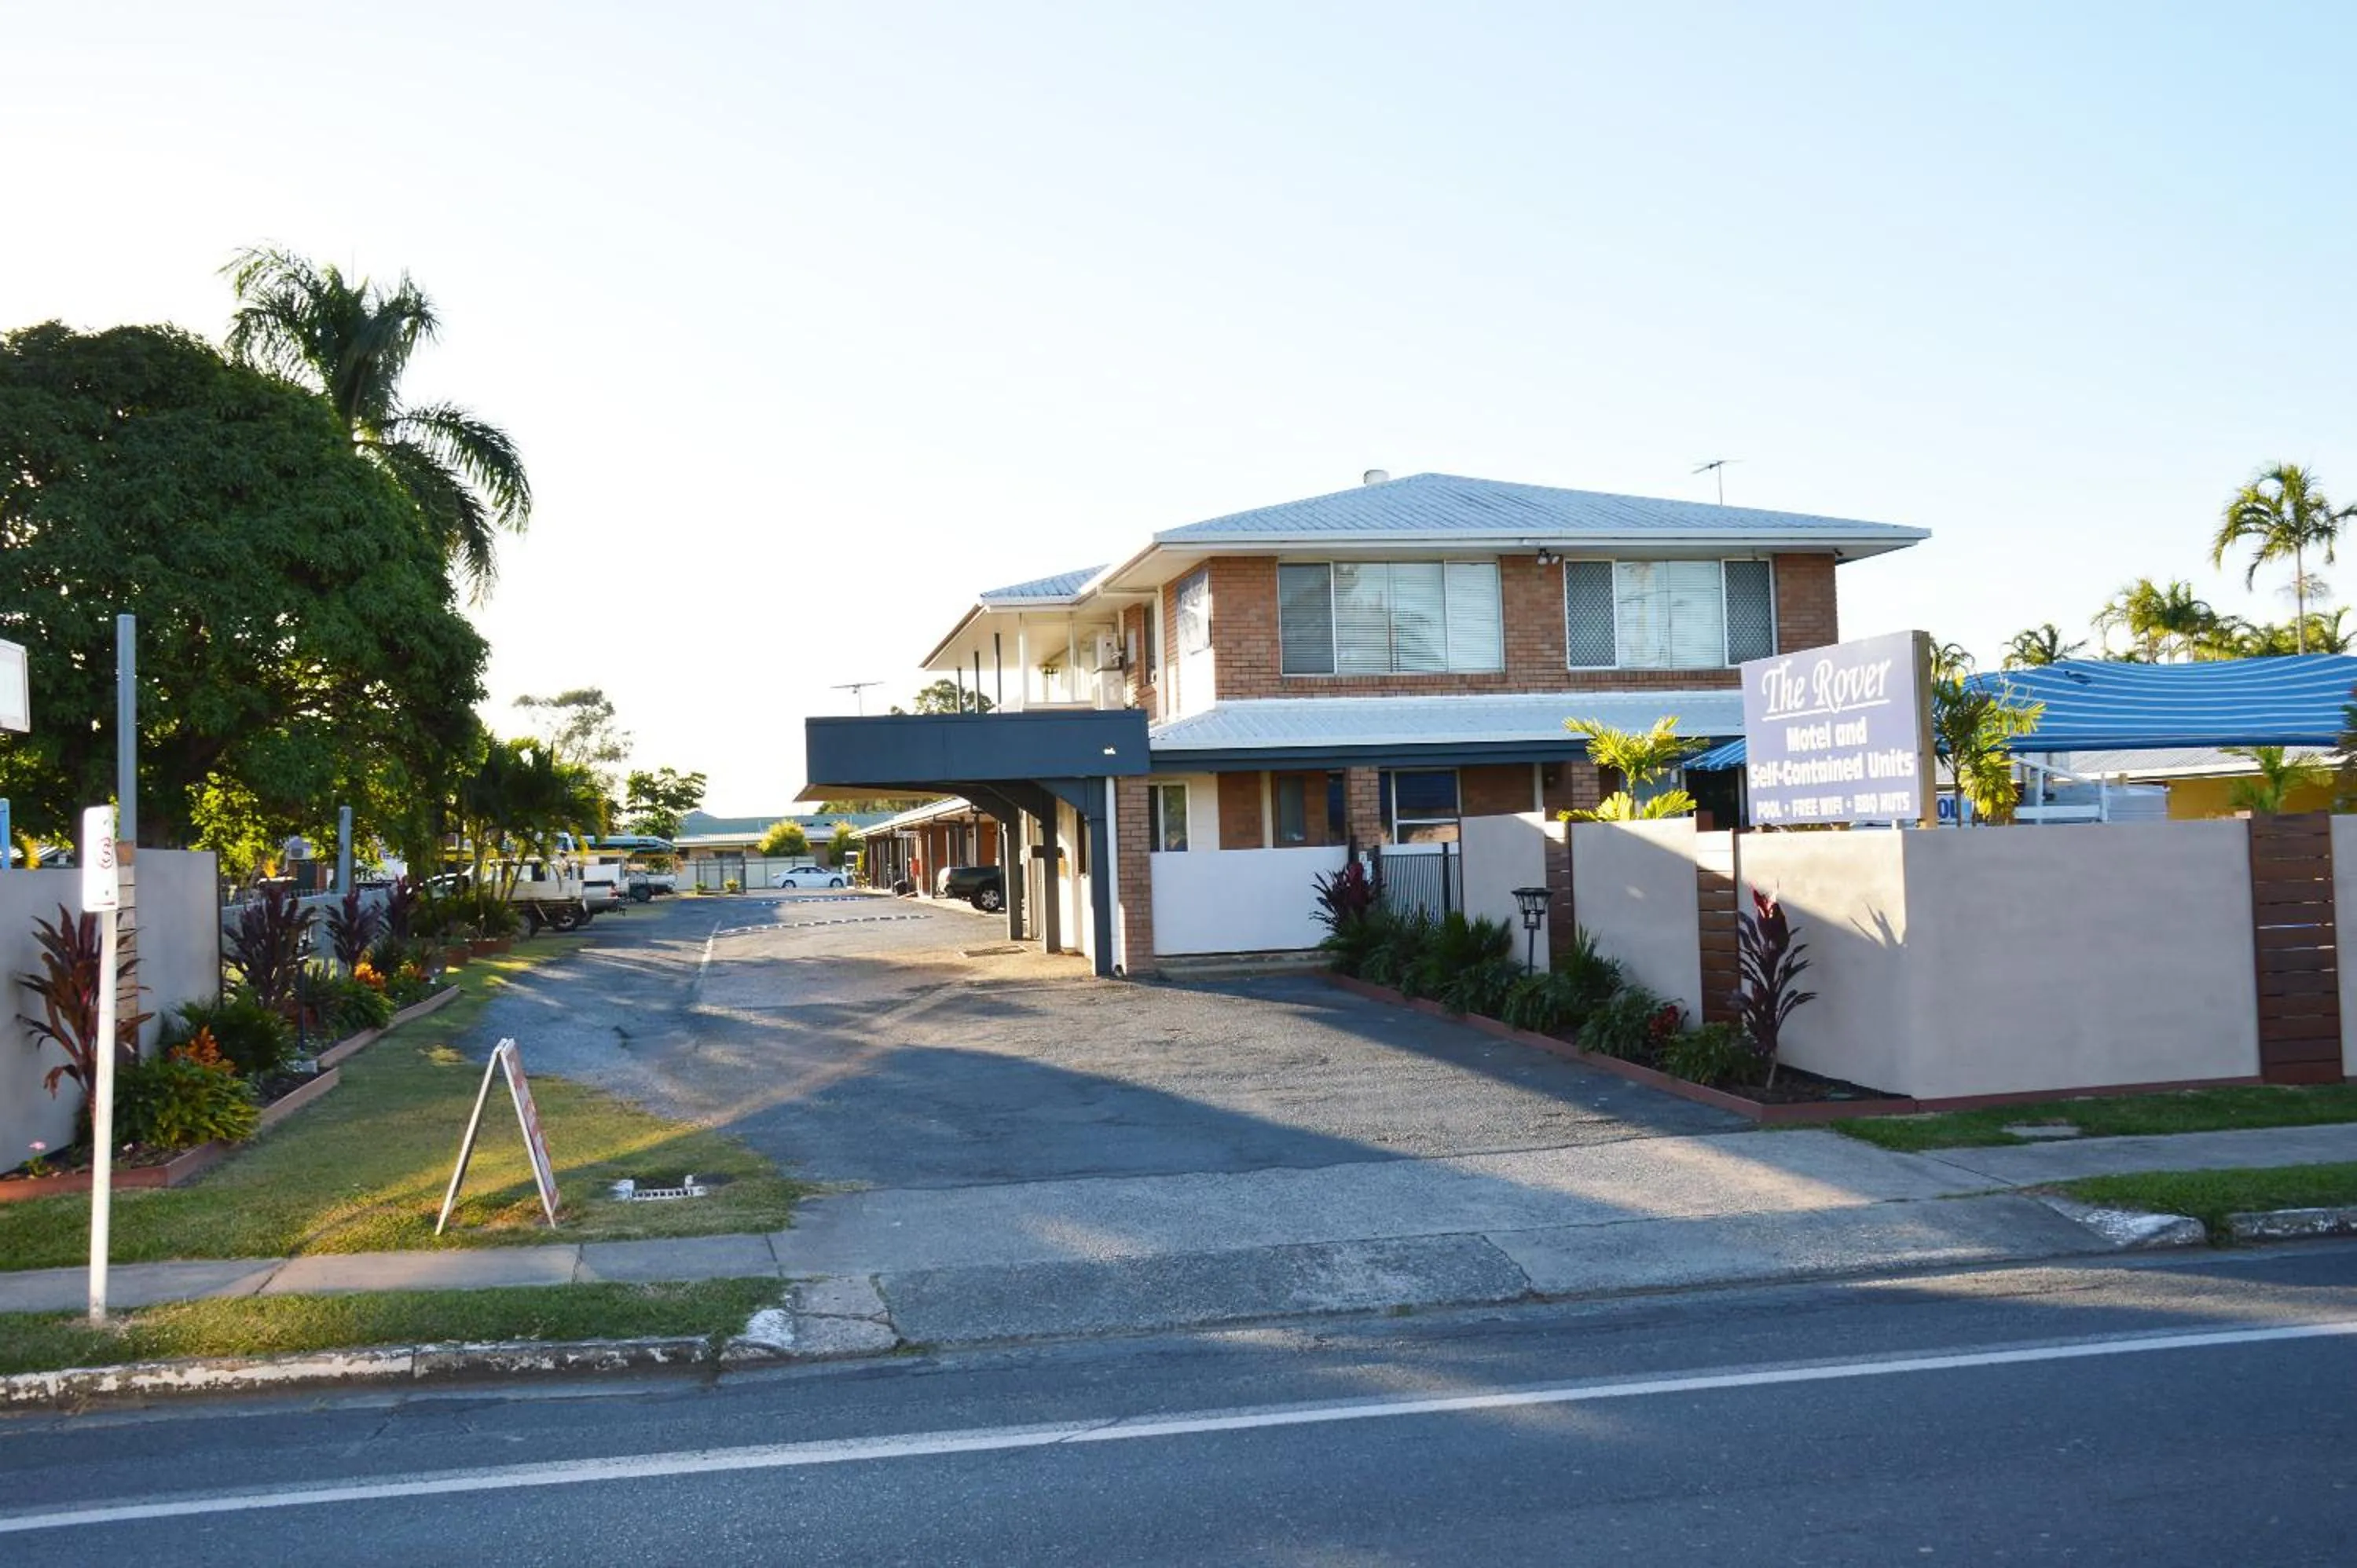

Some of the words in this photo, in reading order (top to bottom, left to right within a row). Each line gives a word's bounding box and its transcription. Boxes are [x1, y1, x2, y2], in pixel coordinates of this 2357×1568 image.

[1761, 659, 1805, 713] The
[1813, 659, 1891, 713] Rover
[1787, 721, 1831, 752] Motel
[1835, 716, 1868, 746] and
[1750, 752, 1864, 788] Self-Contained
[1868, 748, 1915, 779] Units
[1792, 798, 1819, 817] FREE
[1854, 793, 1878, 813] BBQ
[1880, 791, 1910, 811] HUTS
